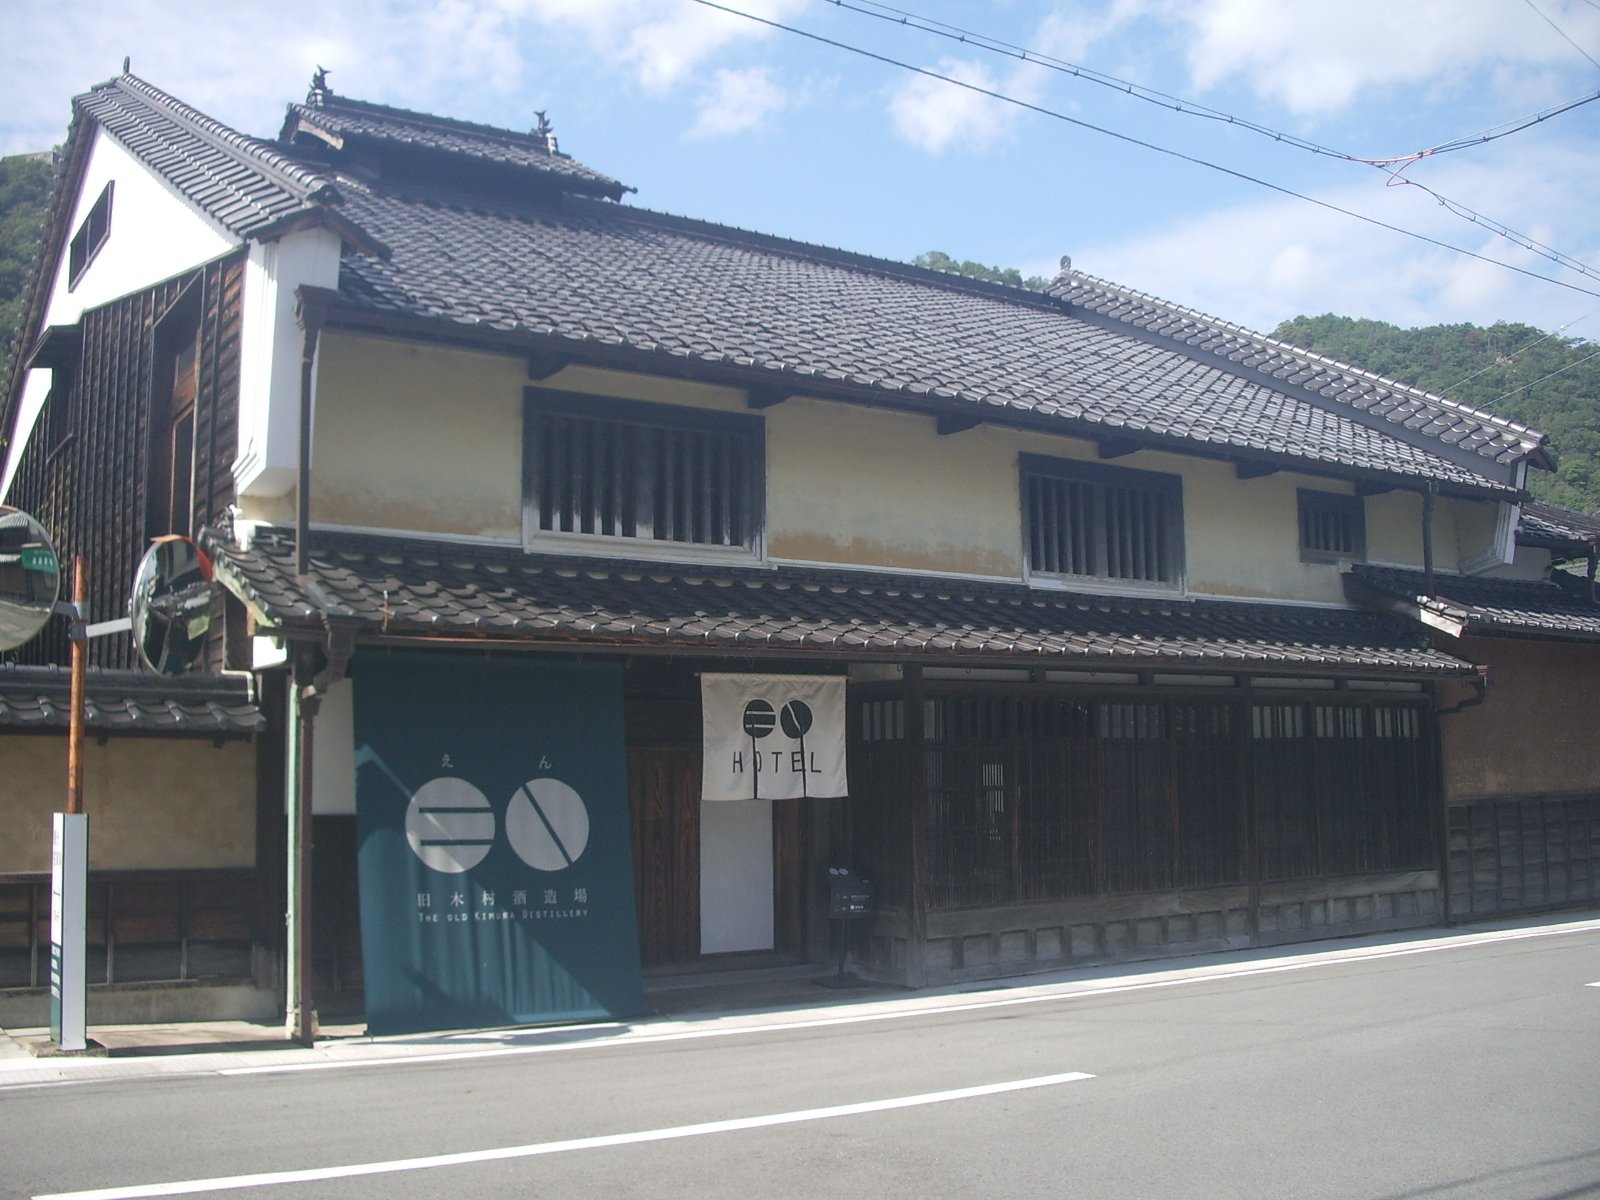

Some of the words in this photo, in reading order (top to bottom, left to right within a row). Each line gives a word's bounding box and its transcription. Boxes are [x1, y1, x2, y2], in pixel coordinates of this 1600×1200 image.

[732, 751, 822, 774] HOTEL
[417, 888, 588, 908] 旧木村酒造場
[447, 913, 468, 922] OLD
